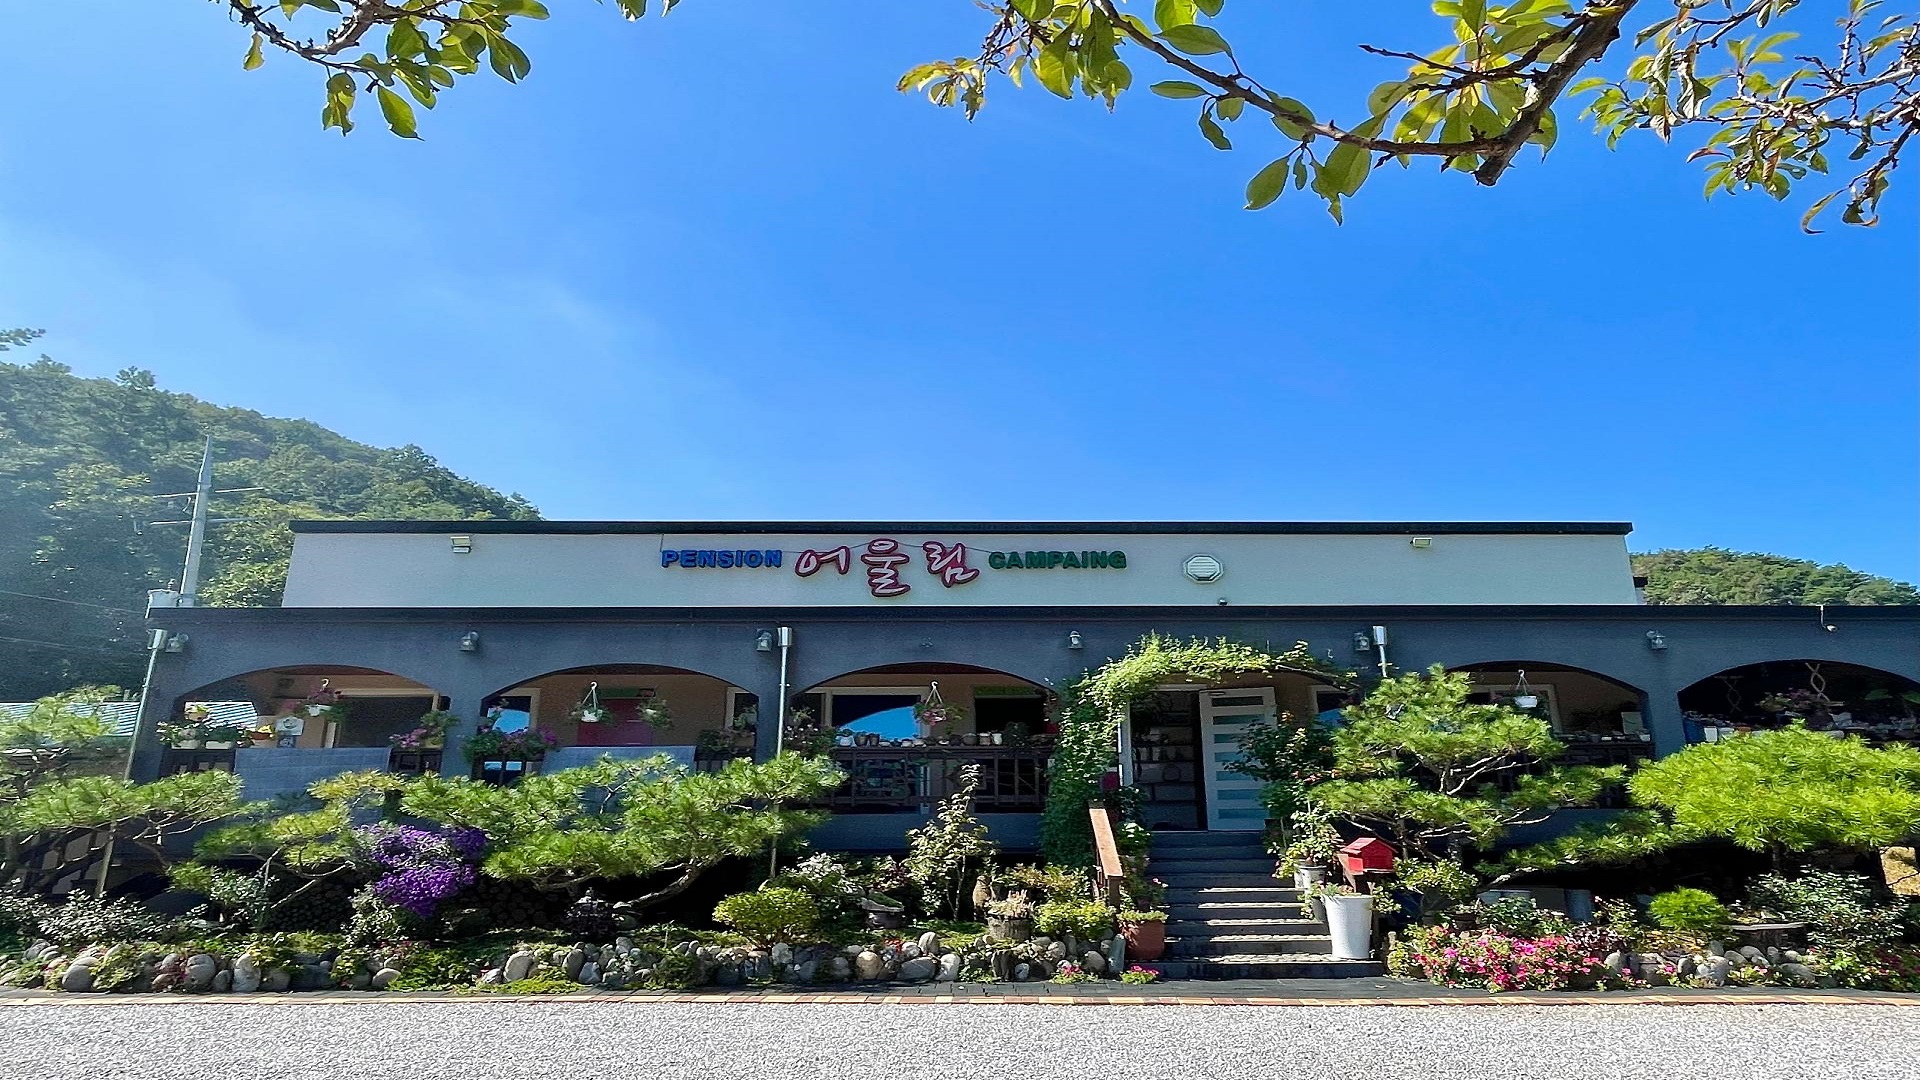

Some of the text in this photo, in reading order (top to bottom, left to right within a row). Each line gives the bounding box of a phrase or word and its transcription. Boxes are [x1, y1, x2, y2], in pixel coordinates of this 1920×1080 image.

[661, 550, 782, 569] PENSION
[795, 538, 980, 597] 어울림
[989, 551, 1127, 570] CAMPAING
